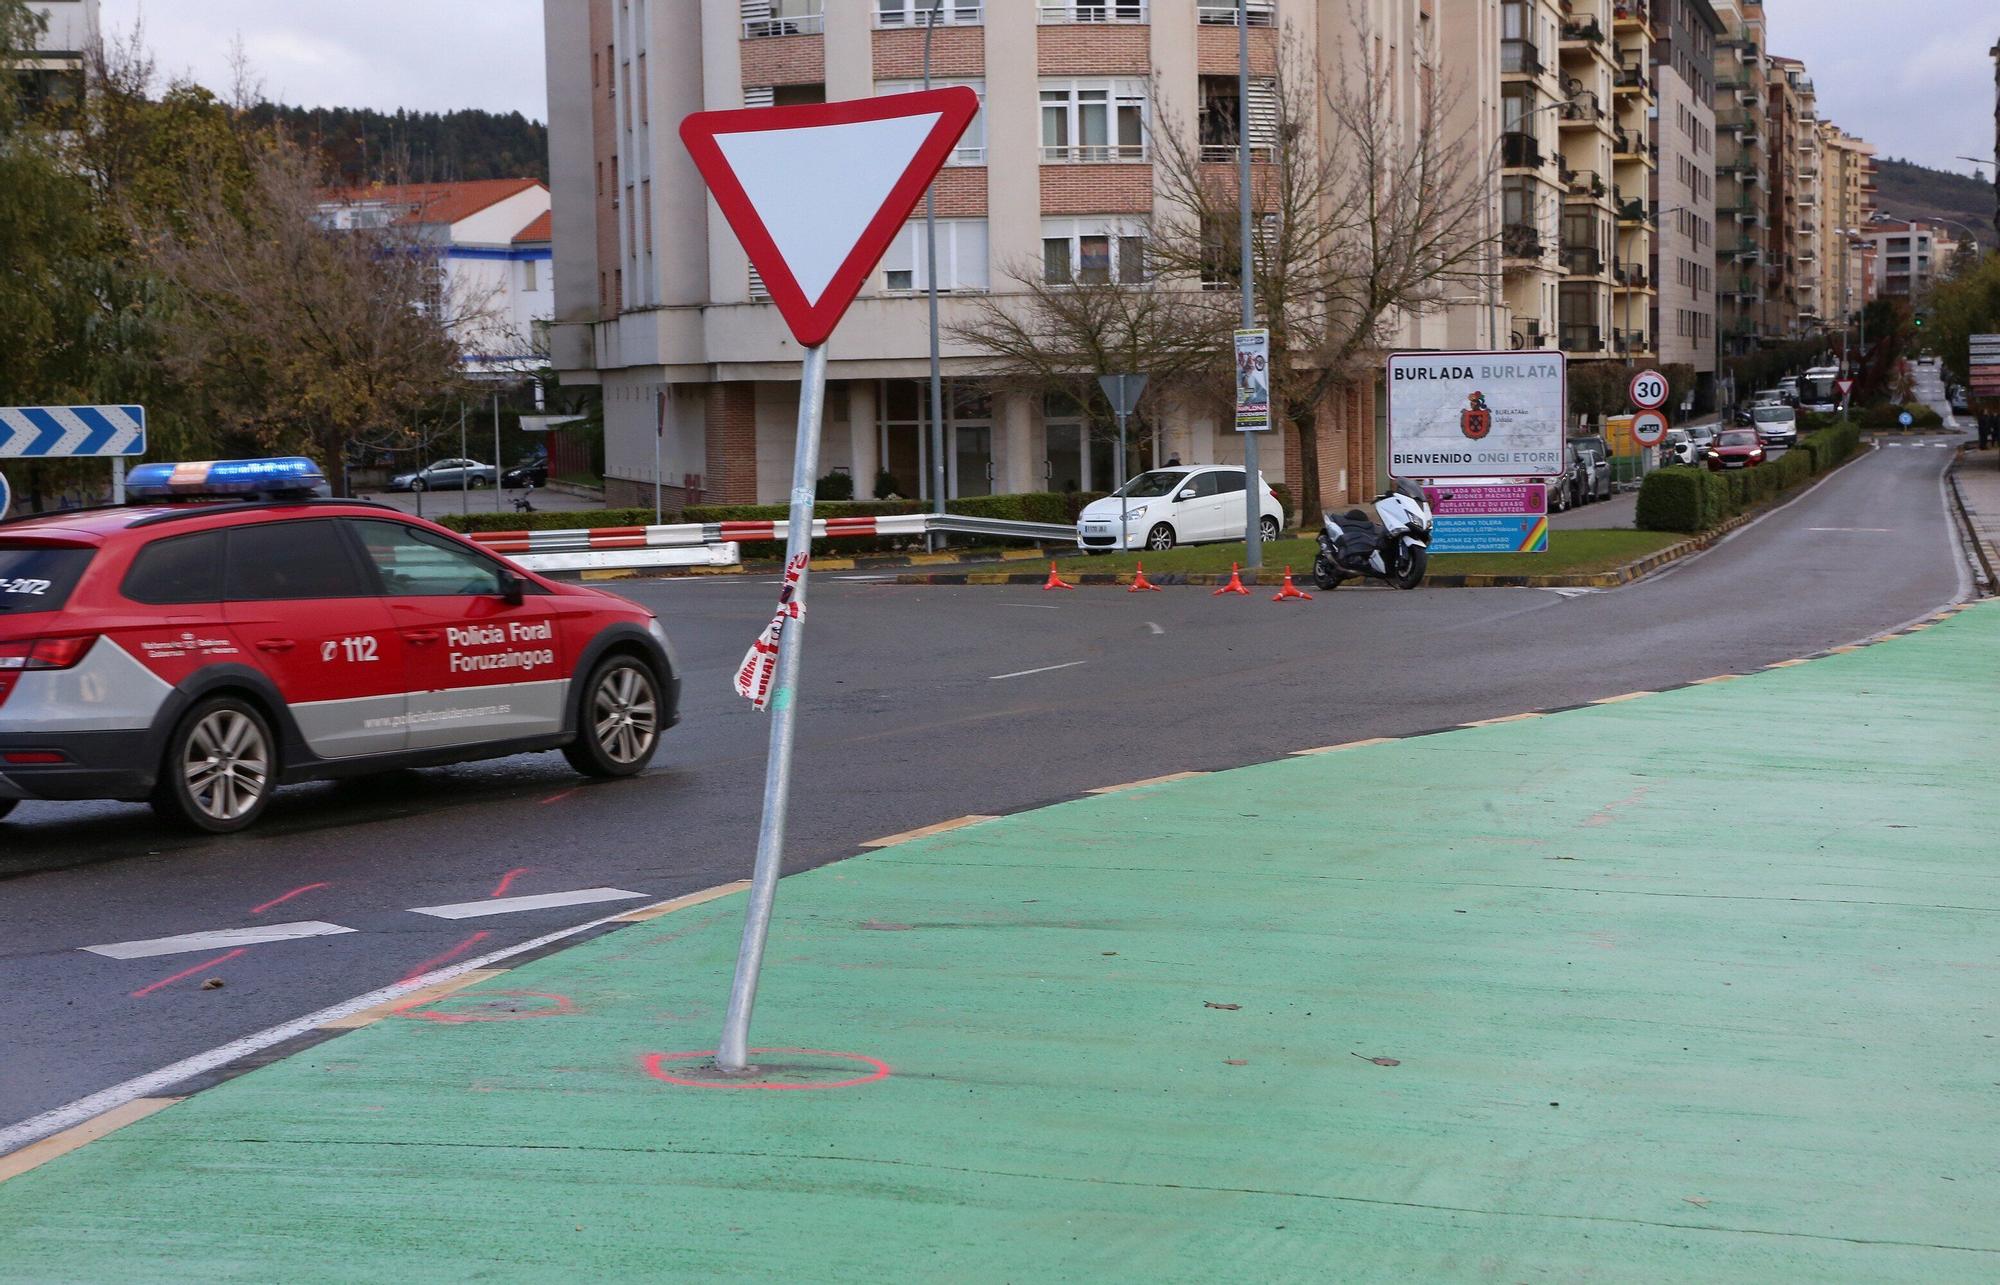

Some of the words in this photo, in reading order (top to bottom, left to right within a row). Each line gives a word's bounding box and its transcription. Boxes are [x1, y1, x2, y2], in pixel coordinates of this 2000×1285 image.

[1394, 366, 1474, 380] BURLADA
[1481, 365, 1558, 379] BURLATA
[1637, 381, 1661, 398] 30
[1394, 453, 1472, 464] BIENVENIDO
[1477, 452, 1509, 463] ONGI
[1513, 452, 1559, 462] ETORRI
[508, 620, 552, 642] Foral
[341, 635, 380, 662] 112
[450, 648, 554, 673] Foruzaingoa
